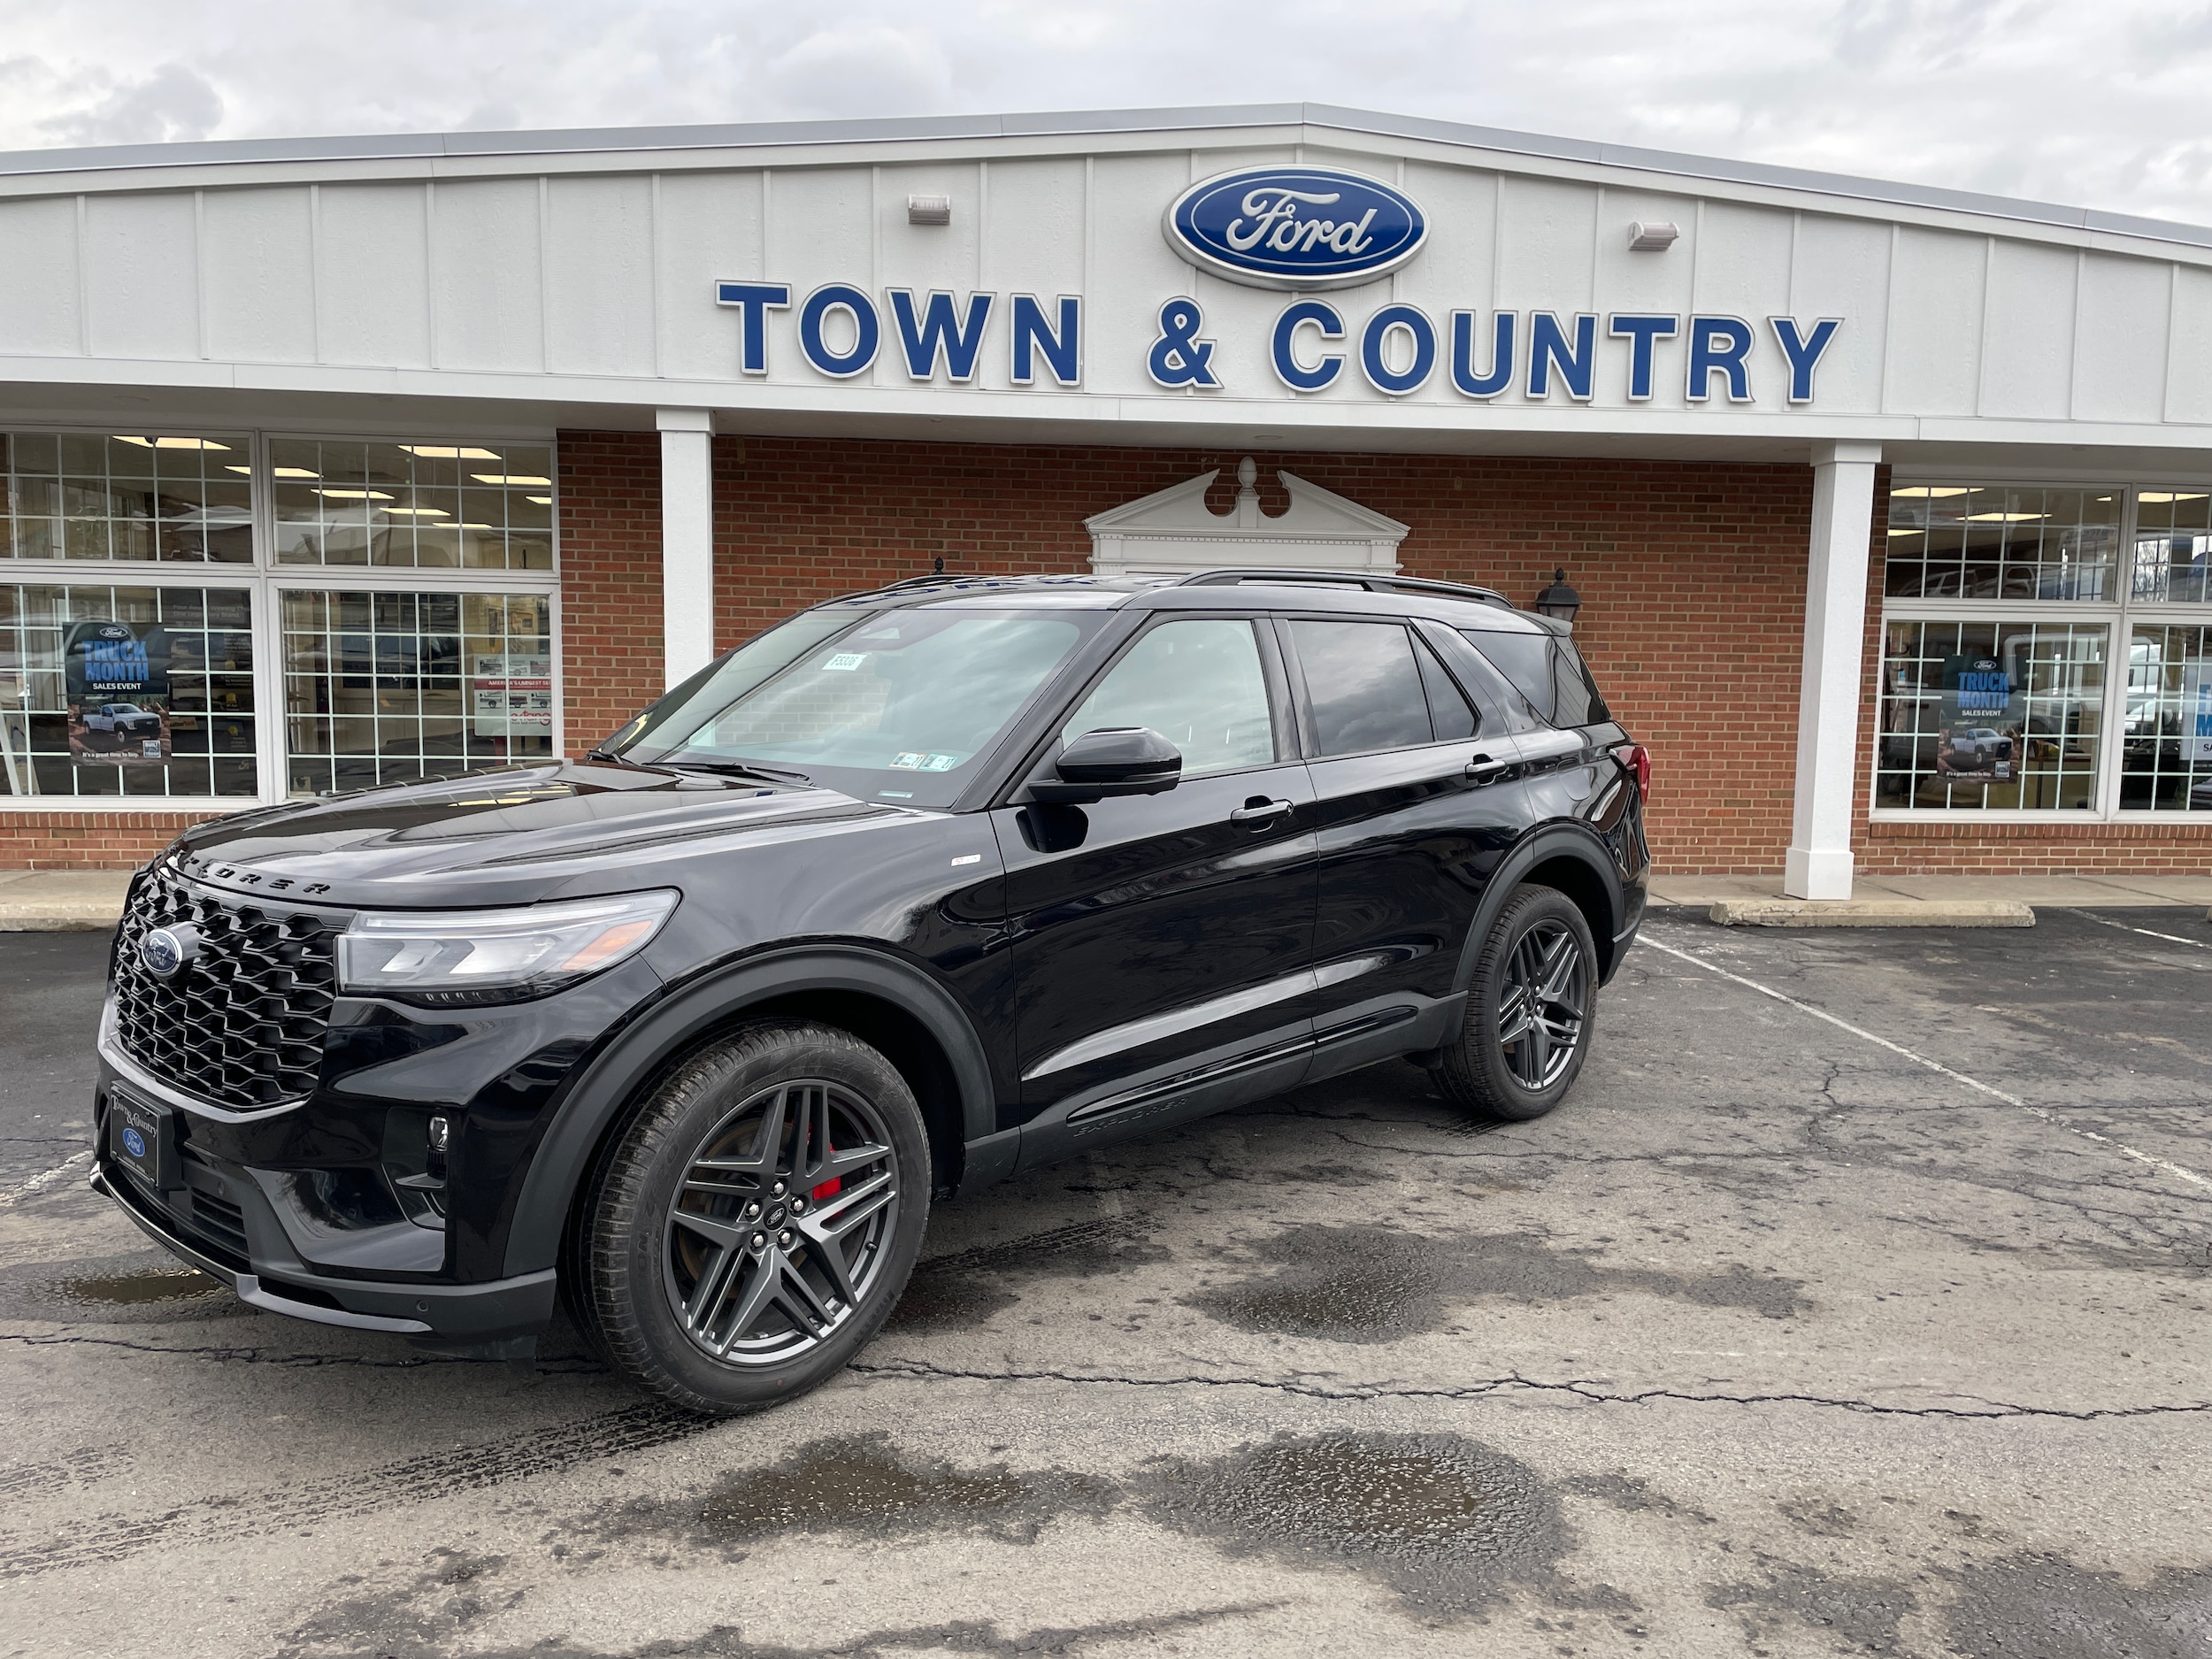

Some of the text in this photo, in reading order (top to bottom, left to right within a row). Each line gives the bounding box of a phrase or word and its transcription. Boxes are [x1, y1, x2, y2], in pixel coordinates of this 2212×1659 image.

[1226, 188, 1378, 254] Ford
[715, 280, 1845, 403] TOWN & COUNTRY
[82, 640, 149, 662] TRUCK
[85, 661, 150, 681] MONTH
[1958, 672, 2010, 691] TRUCK
[1957, 691, 2010, 709] MONTH
[145, 937, 170, 966] Ford
[127, 1132, 142, 1153] Ford
